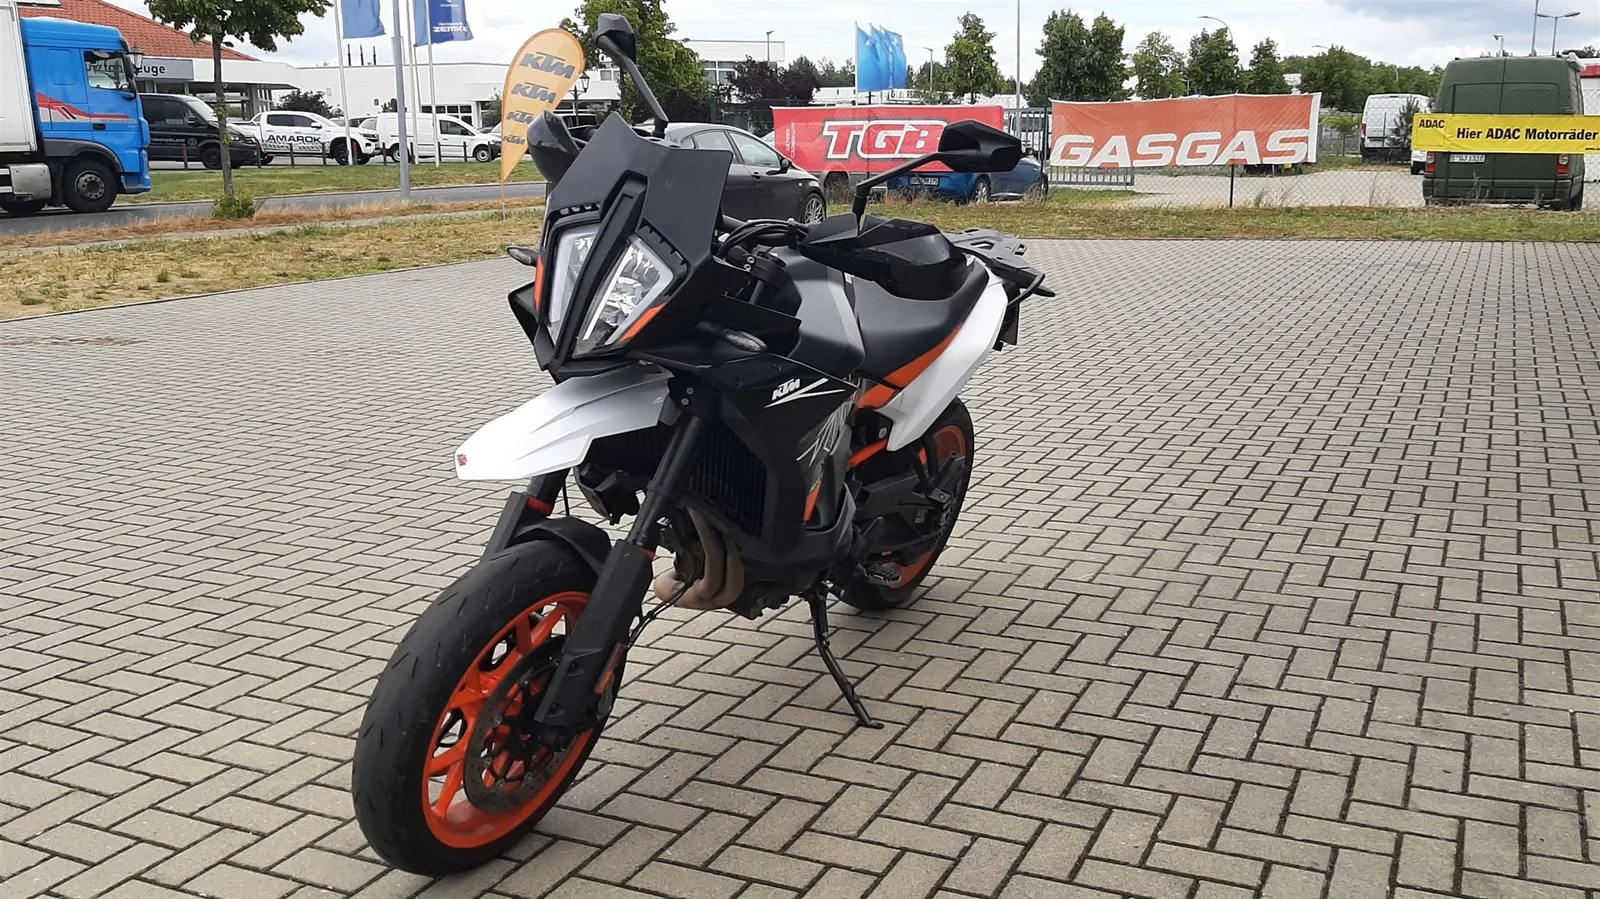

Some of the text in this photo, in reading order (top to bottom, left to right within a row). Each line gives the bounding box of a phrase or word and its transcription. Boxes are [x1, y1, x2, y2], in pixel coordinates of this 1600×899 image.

[519, 51, 575, 79] KTM
[511, 82, 556, 103] KTM
[1418, 119, 1445, 129] ADAC
[1456, 127, 1599, 141] Hier ADAC Motorräder
[267, 134, 321, 144] AMAROK
[502, 134, 526, 146] KTM
[822, 120, 947, 159] TGB
[1050, 129, 1310, 167] GASGAS
[771, 378, 801, 401] KTM
